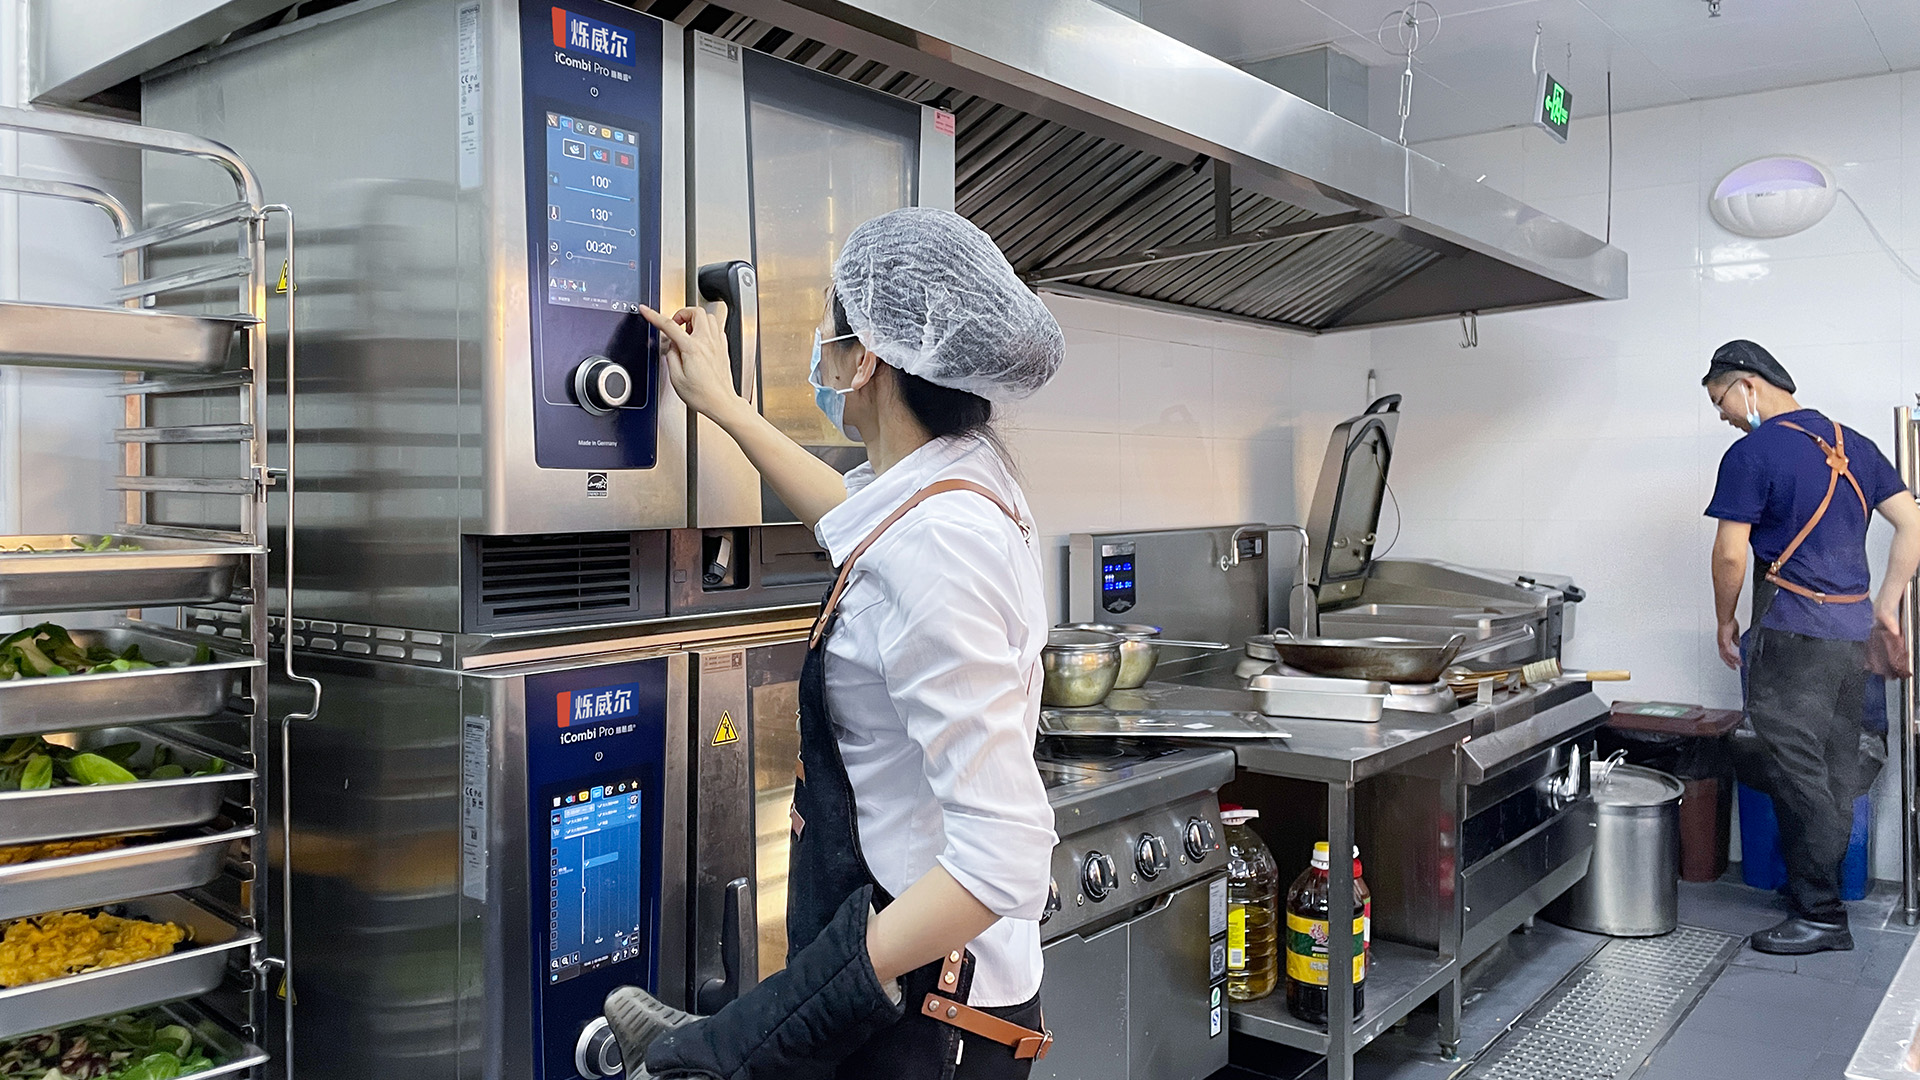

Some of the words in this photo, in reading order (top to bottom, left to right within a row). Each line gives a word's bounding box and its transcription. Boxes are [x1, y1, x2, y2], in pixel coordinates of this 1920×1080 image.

[570, 19, 628, 58] 烁威尔
[554, 51, 592, 72] iCombi
[594, 62, 610, 77] Pro
[597, 440, 618, 448] Germany
[575, 690, 632, 720] 烁威尔
[560, 727, 597, 745] iCombi
[599, 726, 615, 738] Pro
